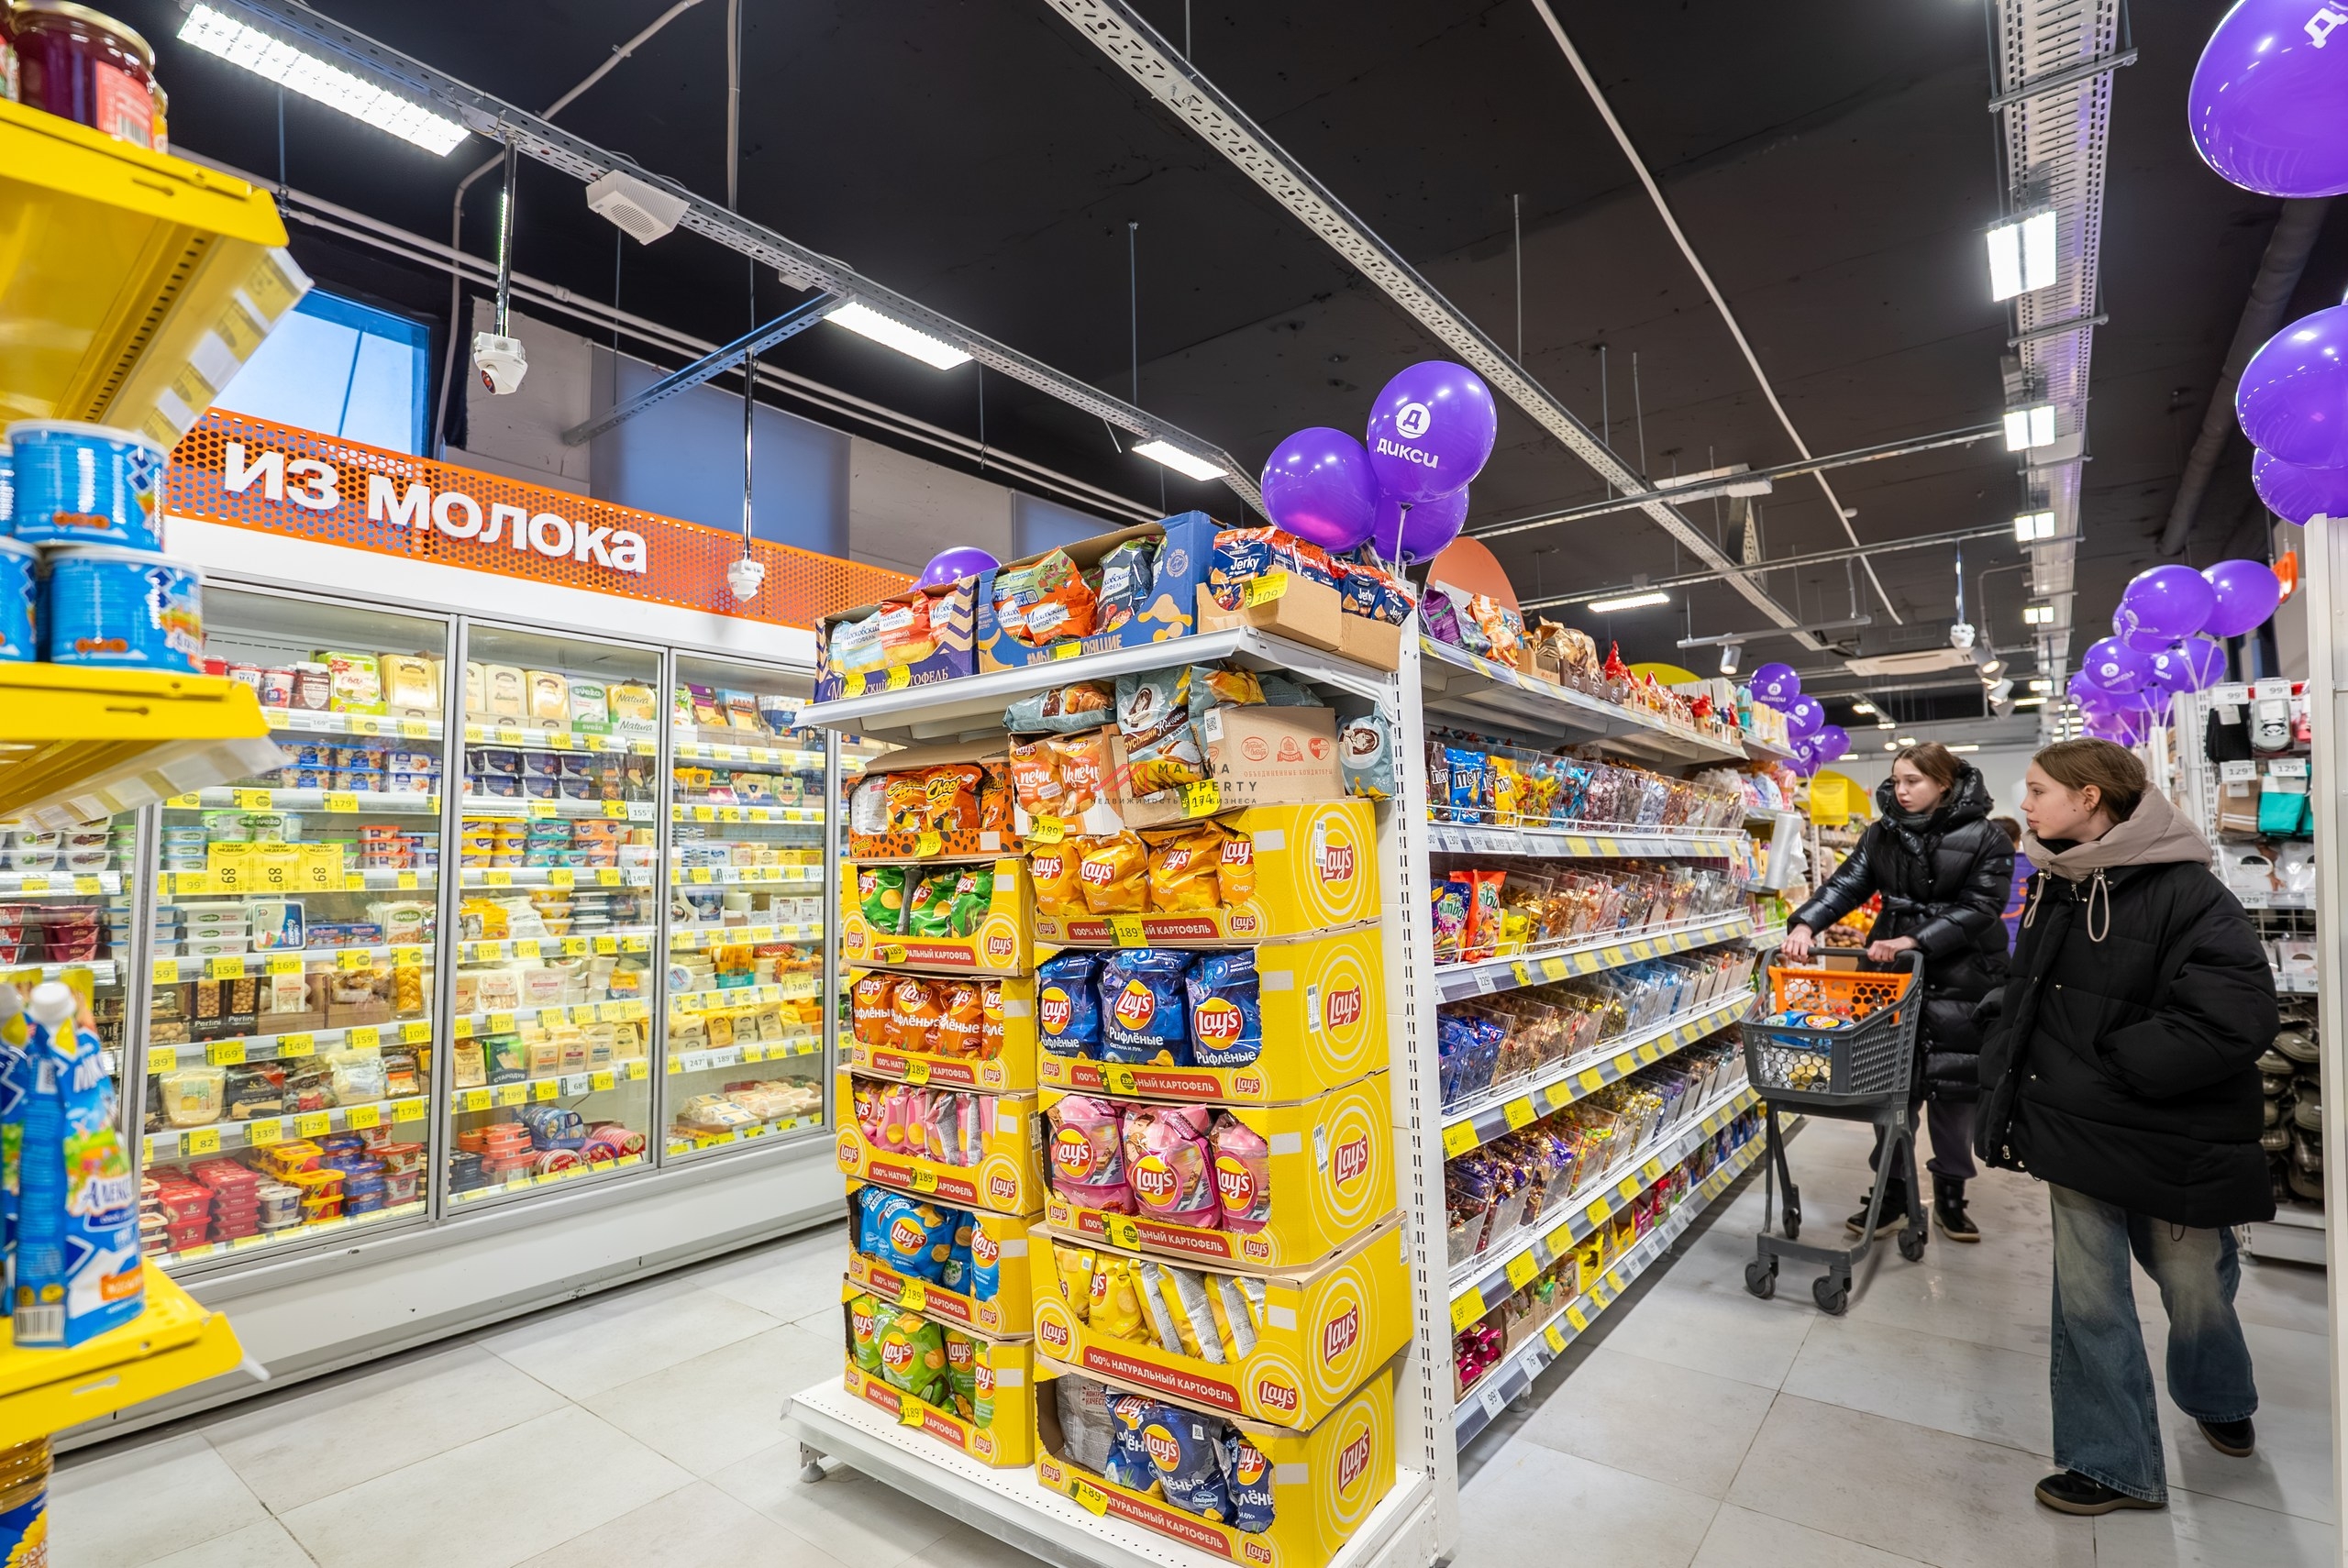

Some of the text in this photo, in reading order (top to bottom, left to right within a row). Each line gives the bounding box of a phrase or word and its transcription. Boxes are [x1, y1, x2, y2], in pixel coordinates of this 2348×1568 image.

[367, 472, 648, 575] молока
[1230, 557, 1259, 570] Jerky
[893, 678, 905, 686] 129
[617, 694, 648, 704] Natura
[620, 721, 652, 731] Natura
[1124, 729, 1157, 750] РУСТЯЩИЙ
[1040, 825, 1058, 836] 189
[926, 843, 936, 851] 69
[1080, 862, 1114, 889] Lay's
[1037, 922, 1057, 935] Lay's
[1072, 928, 1094, 936] 100%
[1158, 924, 1211, 935] КАРТОФЕЛЬ
[1119, 927, 1138, 938] 189
[1231, 915, 1256, 933] Lay's
[847, 931, 864, 948] Lay's
[987, 936, 1013, 956] Lay's
[935, 951, 971, 961] КАРТОФЕЛЬ
[216, 965, 237, 975] 159
[276, 961, 296, 971] 169
[858, 978, 882, 997] Lay's
[1116, 989, 1152, 1019] Lay's
[1327, 985, 1361, 1031] Lay's
[1199, 1011, 1239, 1038] Lay's
[356, 1034, 373, 1044] 159
[408, 1029, 426, 1039] 109
[1109, 1028, 1164, 1046] Рифлёные
[289, 1041, 308, 1051] 149
[1196, 1050, 1257, 1066] Рифлёные
[876, 1058, 890, 1067] 100%
[932, 1067, 970, 1079] КАРТОФЕЛЬ
[912, 1066, 925, 1075] 189
[984, 1067, 1001, 1083] Lay's
[1042, 1062, 1059, 1076] Lay's
[1076, 1072, 1096, 1082] 100%
[1159, 1078, 1214, 1091] КАРТОФЕЛЬ
[1236, 1077, 1260, 1095] Lay's
[356, 1113, 373, 1123] 159
[401, 1107, 418, 1116] 179
[256, 1129, 274, 1138] 339
[305, 1121, 323, 1131] 129
[840, 1143, 859, 1162] Lay's
[1057, 1142, 1091, 1166] Lay's
[1335, 1133, 1368, 1187] Lay's
[872, 1166, 888, 1178] 100%
[919, 1171, 933, 1183] 189
[1136, 1165, 1176, 1196] Lay's
[991, 1176, 1016, 1198] Lay's
[1050, 1205, 1068, 1222] Lay's
[892, 1222, 926, 1250] Lay's
[1167, 1233, 1224, 1254] КАРТОФЕЛЬ
[1244, 1240, 1269, 1258] Lay's
[873, 1275, 967, 1315] 100% КАРТОФЕЛЬ
[907, 1288, 922, 1301] 189
[980, 1308, 996, 1324] Lay's
[1042, 1321, 1069, 1346] Lay's
[1324, 1302, 1359, 1367] Lay's
[881, 1339, 914, 1368] Lay's
[946, 1337, 972, 1361] Lay's
[1089, 1352, 1234, 1404] 100% НАТУРАЛЬНЫЙ КАРТОФЕЛЬ
[1258, 1381, 1297, 1409] Lay's
[869, 1386, 961, 1442] 100% КАРТОФЕЛЬ
[905, 1406, 920, 1418] 189
[975, 1435, 991, 1452] Lay's
[1146, 1437, 1180, 1463] Lay's
[1338, 1428, 1370, 1496] Lay's
[1042, 1465, 1060, 1483] Lay's
[1081, 1485, 1102, 1501] 189
[1166, 1521, 1224, 1550] КАРТОФЕЛЬ
[1246, 1542, 1271, 1563] Lay's
